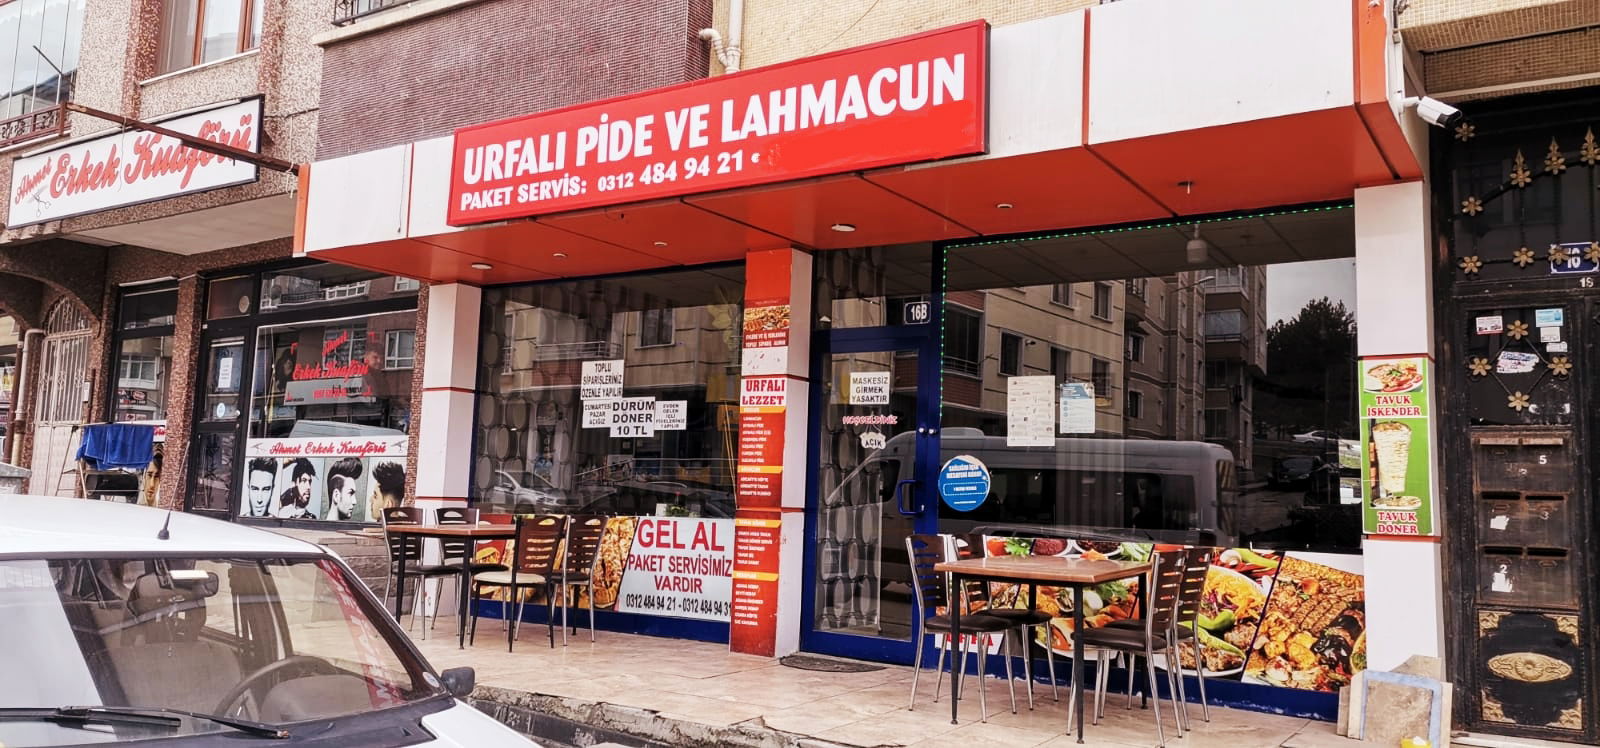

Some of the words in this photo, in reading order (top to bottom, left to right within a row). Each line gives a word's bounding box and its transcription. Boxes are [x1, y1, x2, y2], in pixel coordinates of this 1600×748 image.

[463, 131, 567, 185] URFALI
[575, 113, 655, 167] PİDE
[664, 104, 711, 151] VE
[720, 53, 965, 143] LAHMACUN
[15, 156, 51, 205] Ahmet
[50, 144, 122, 199] Erkek
[460, 187, 514, 211] PAKET
[517, 173, 587, 204] SERVİS:
[597, 172, 635, 192] 0312
[639, 160, 678, 186] 484
[683, 155, 710, 180] 94
[716, 149, 744, 174] 21
[910, 304, 928, 321] 16B
[292, 364, 322, 381] Erkek
[595, 363, 612, 373] TOPLU
[745, 379, 786, 392] URFALI
[852, 376, 889, 385] MASKESİZ
[855, 385, 884, 394] GİRMEK
[612, 399, 655, 411] DÜRÜM
[741, 395, 785, 406] LEZZET
[1375, 395, 1412, 405] TAVUK
[1367, 404, 1421, 417] İSKENDER
[612, 412, 653, 423] DÖNER
[617, 426, 630, 435] 10
[634, 425, 648, 435] TL
[269, 441, 302, 455] Ahmet
[304, 441, 335, 455] Erkek
[336, 440, 387, 458] Kuaförü
[1538, 455, 1547, 465] 5
[1378, 511, 1417, 522] TAVUK
[1378, 520, 1418, 534] DÖNER
[637, 519, 686, 550] GEL
[691, 521, 725, 552] AL
[628, 554, 665, 573] PAKET
[668, 553, 733, 577] SERVİSİMİZ
[1499, 564, 1508, 574] 2
[654, 575, 703, 594] VARDIR
[626, 593, 642, 608] 0312
[643, 594, 655, 610] 484
[656, 596, 665, 610] 94
[666, 597, 676, 611] 21
[682, 598, 699, 613] 0312
[700, 599, 713, 614] 484
[714, 600, 723, 616] 94
